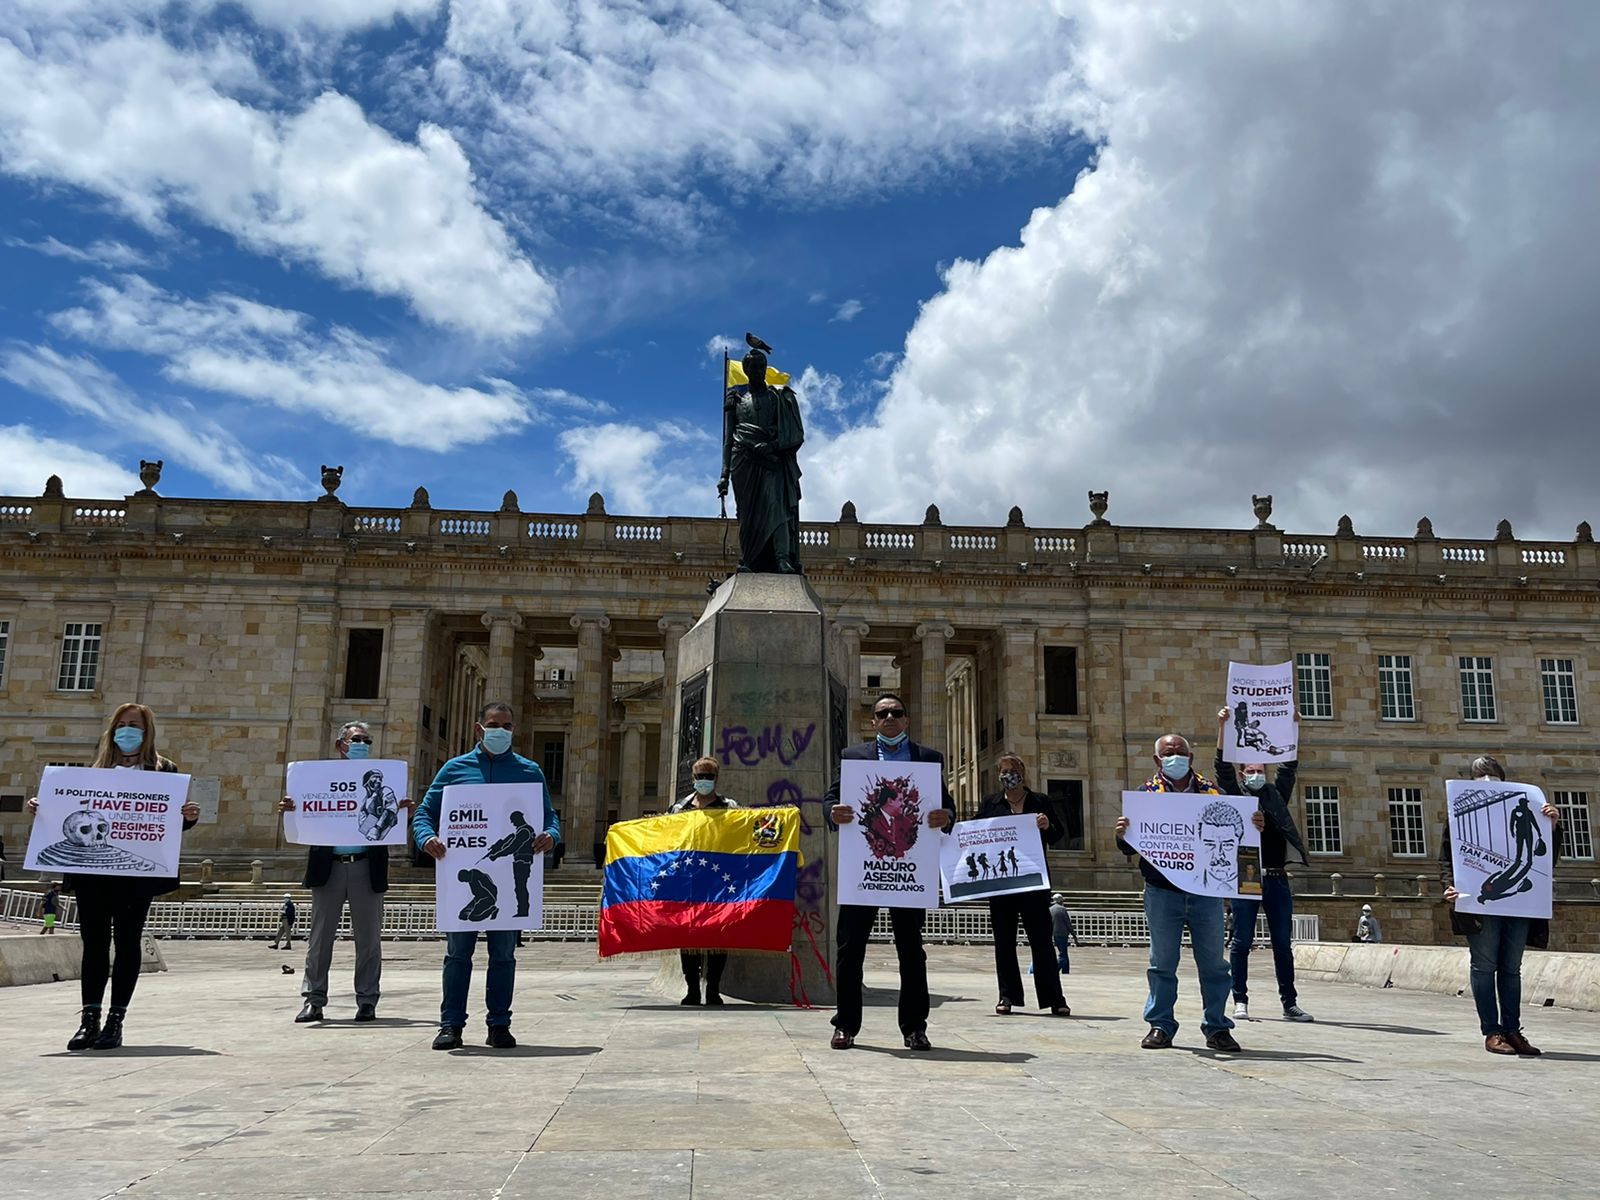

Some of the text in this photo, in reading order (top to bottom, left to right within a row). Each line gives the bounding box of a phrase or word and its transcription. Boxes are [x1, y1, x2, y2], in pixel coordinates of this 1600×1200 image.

[1233, 678, 1257, 686] MORE
[1232, 685, 1292, 696] STUDENTS
[330, 782, 357, 792] 505
[55, 788, 170, 801] 14 POLITICAL PRISONERS
[92, 799, 168, 813] HAVE DIED
[303, 800, 358, 812] KILLED
[108, 812, 166, 823] UNDER THE
[449, 809, 488, 822] 6MIL
[111, 822, 165, 832] REGIME'S
[1140, 822, 1195, 835] INICIEN
[110, 831, 165, 841] CUSTODY
[447, 836, 487, 848] FAES
[959, 839, 994, 848] DICTADURA
[1139, 841, 1194, 851] CONTRA EL
[1460, 845, 1481, 857] RAN
[1482, 854, 1509, 869] AWAY
[864, 860, 917, 872] MADURO
[1151, 859, 1195, 871] ADURO
[863, 871, 916, 883] ASESINA
[862, 882, 925, 892] VENEZOLANOS
